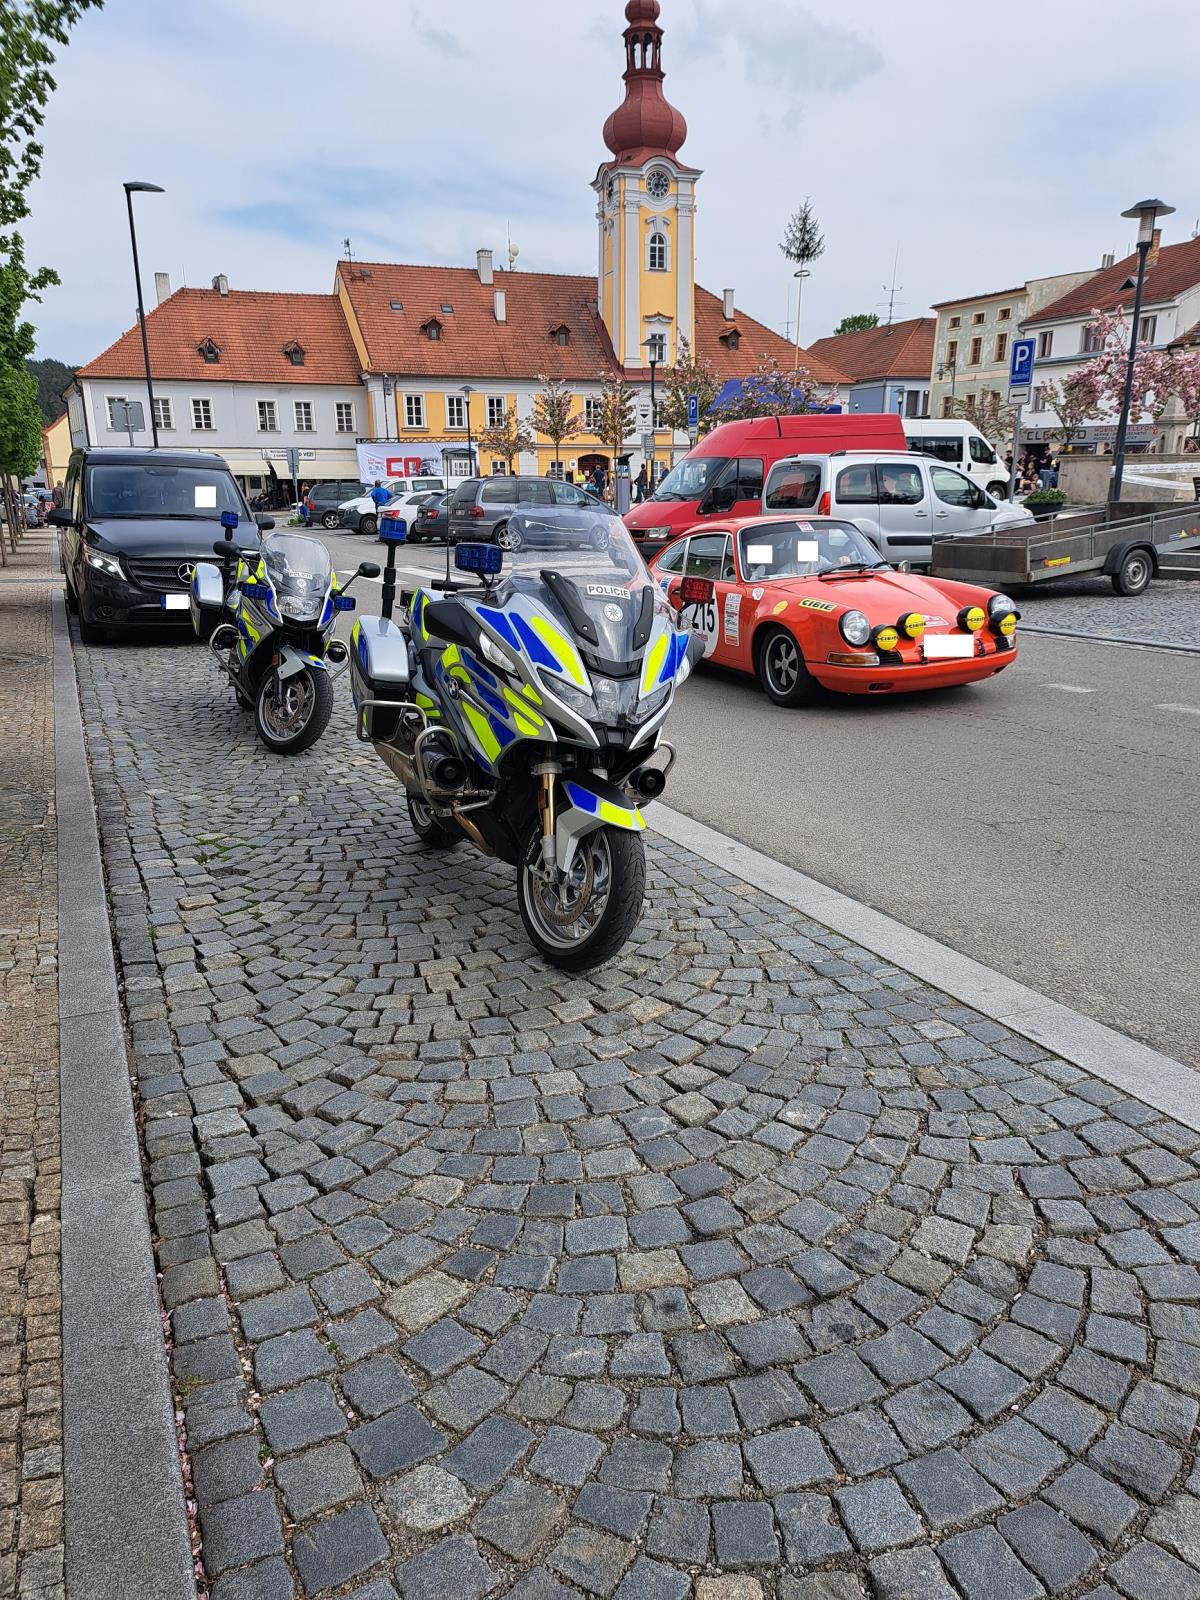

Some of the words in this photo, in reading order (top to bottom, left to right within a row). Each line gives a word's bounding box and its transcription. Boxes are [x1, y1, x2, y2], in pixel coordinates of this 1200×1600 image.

[1015, 345, 1030, 371] P
[690, 398, 696, 417] P
[1026, 429, 1087, 441] ELEKO
[588, 585, 629, 598] POLICIE
[802, 599, 834, 611] CIBIE
[692, 598, 716, 633] 215
